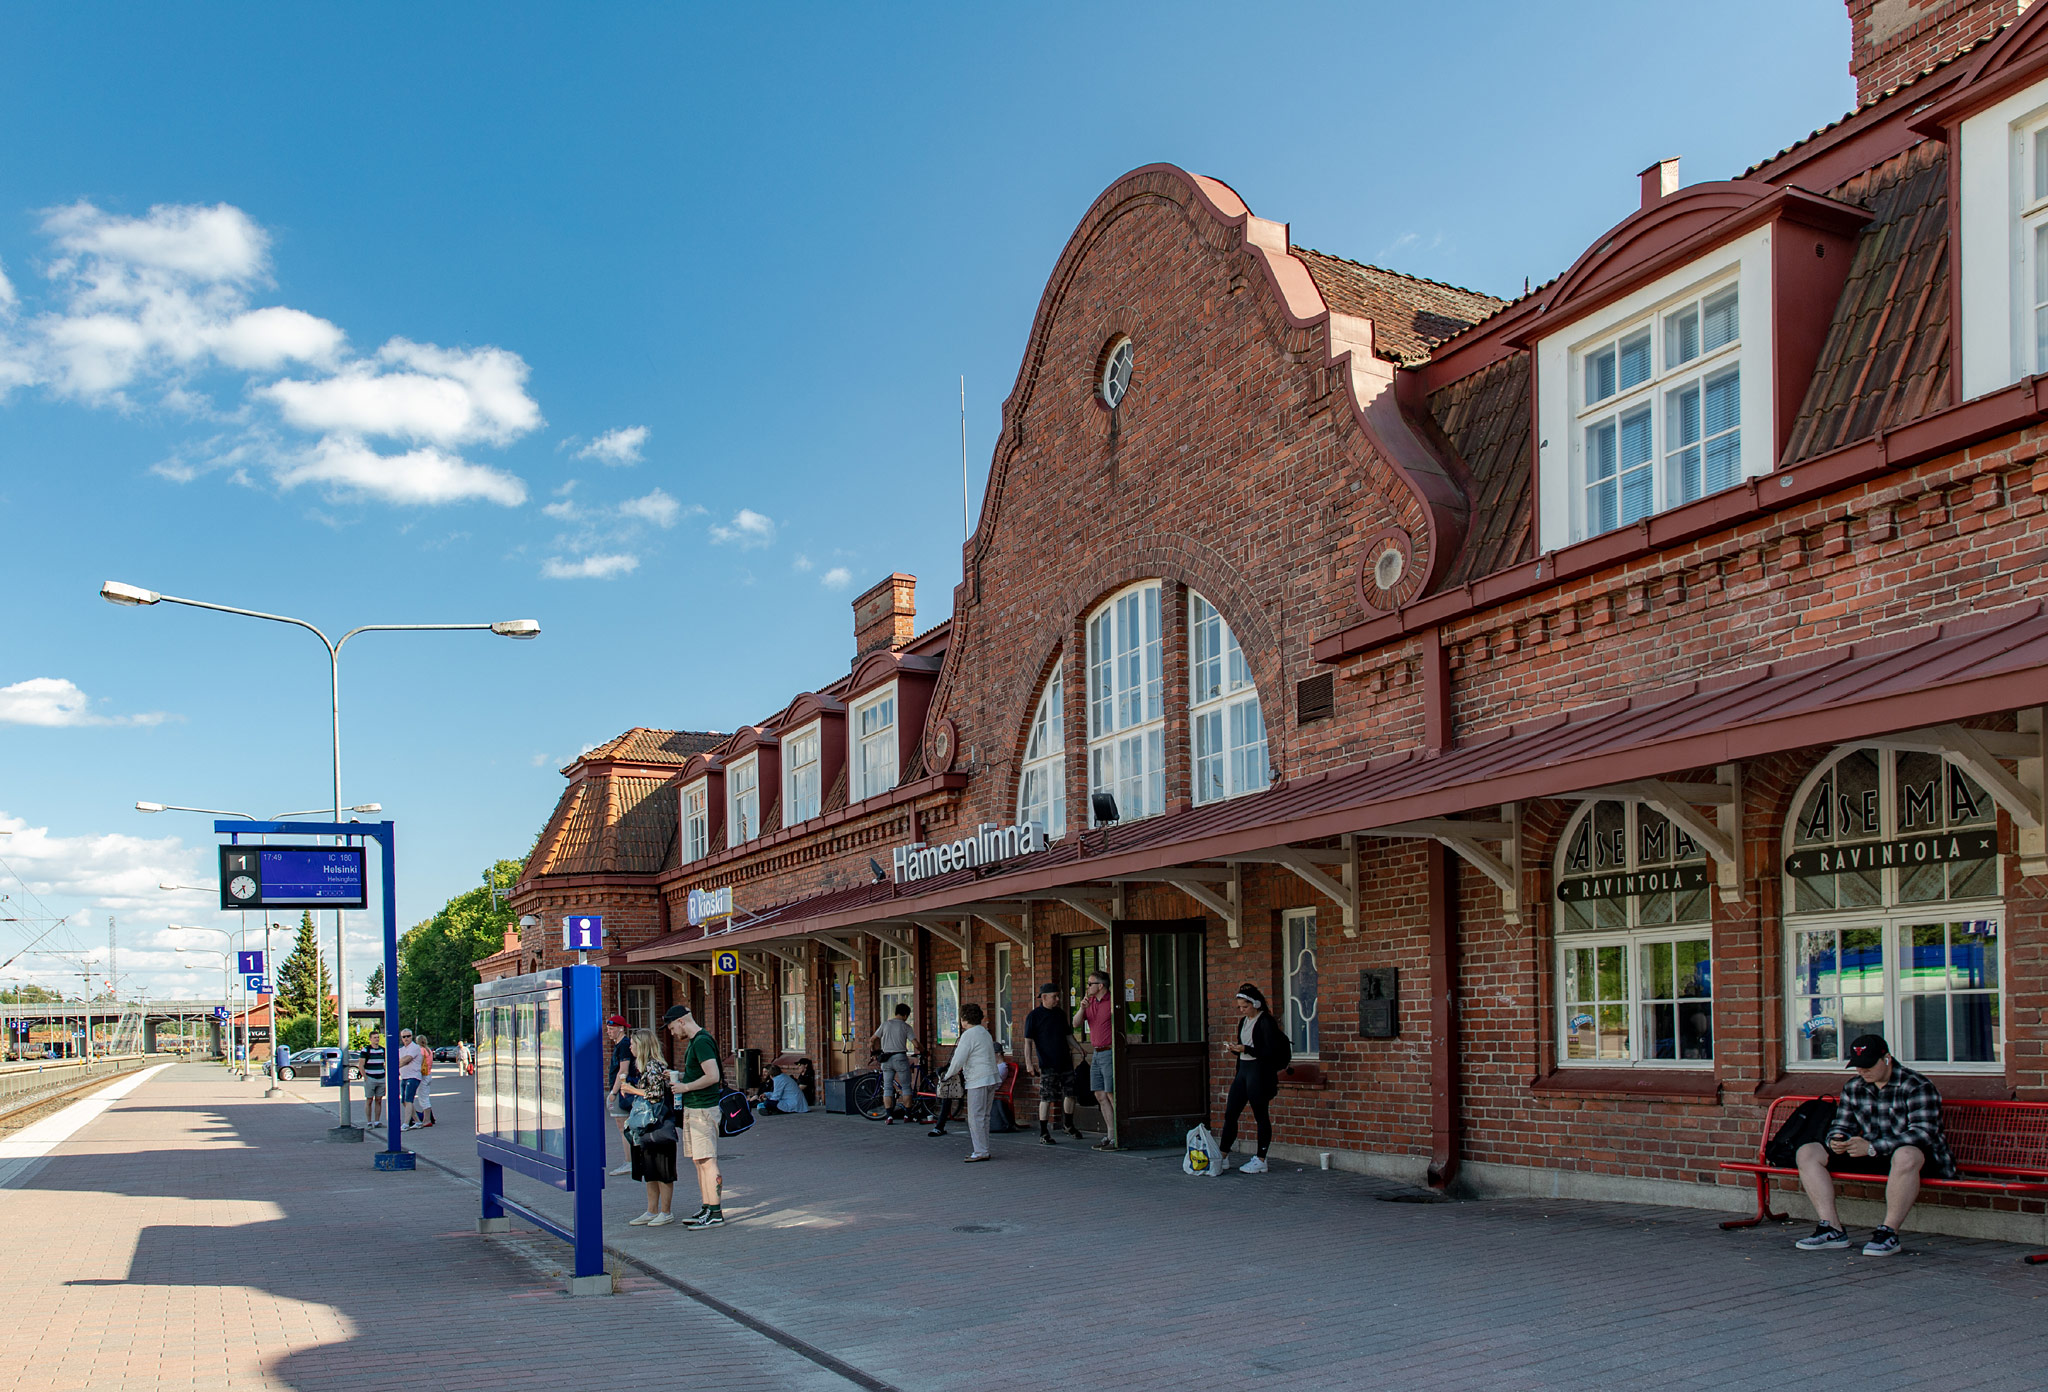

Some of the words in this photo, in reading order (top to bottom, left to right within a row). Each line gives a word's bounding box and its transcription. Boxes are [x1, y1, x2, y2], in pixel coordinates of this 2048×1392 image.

[1805, 763, 1981, 840] ASEMA
[893, 821, 1035, 884] Hämeenlinna
[1820, 837, 1960, 871] RAVINTOLA
[238, 856, 246, 870] 1
[323, 865, 358, 873] Helsinki
[1582, 871, 1682, 898] RAVINTOLA
[689, 897, 696, 920] R
[699, 890, 723, 918] kioski
[246, 955, 254, 970] 1
[722, 957, 733, 969] R
[250, 978, 260, 988] C
[1129, 1013, 1147, 1022] VR
